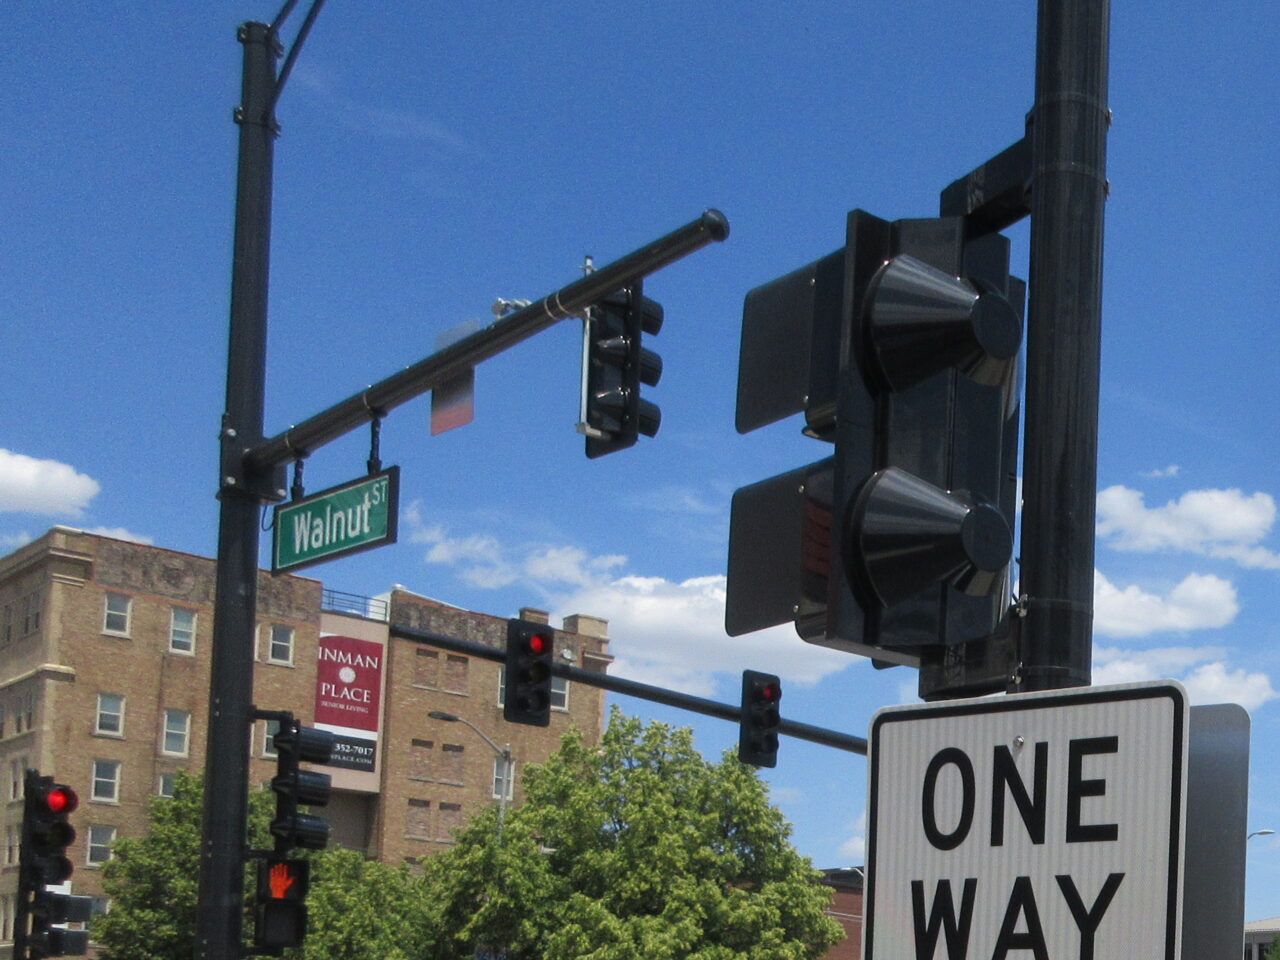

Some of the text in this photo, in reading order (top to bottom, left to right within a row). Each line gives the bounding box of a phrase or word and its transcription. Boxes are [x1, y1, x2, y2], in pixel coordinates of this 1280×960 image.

[294, 480, 388, 555] Walnut ST
[317, 646, 380, 670] INMAN
[320, 682, 372, 704] PLACE
[921, 735, 1120, 851] ONE
